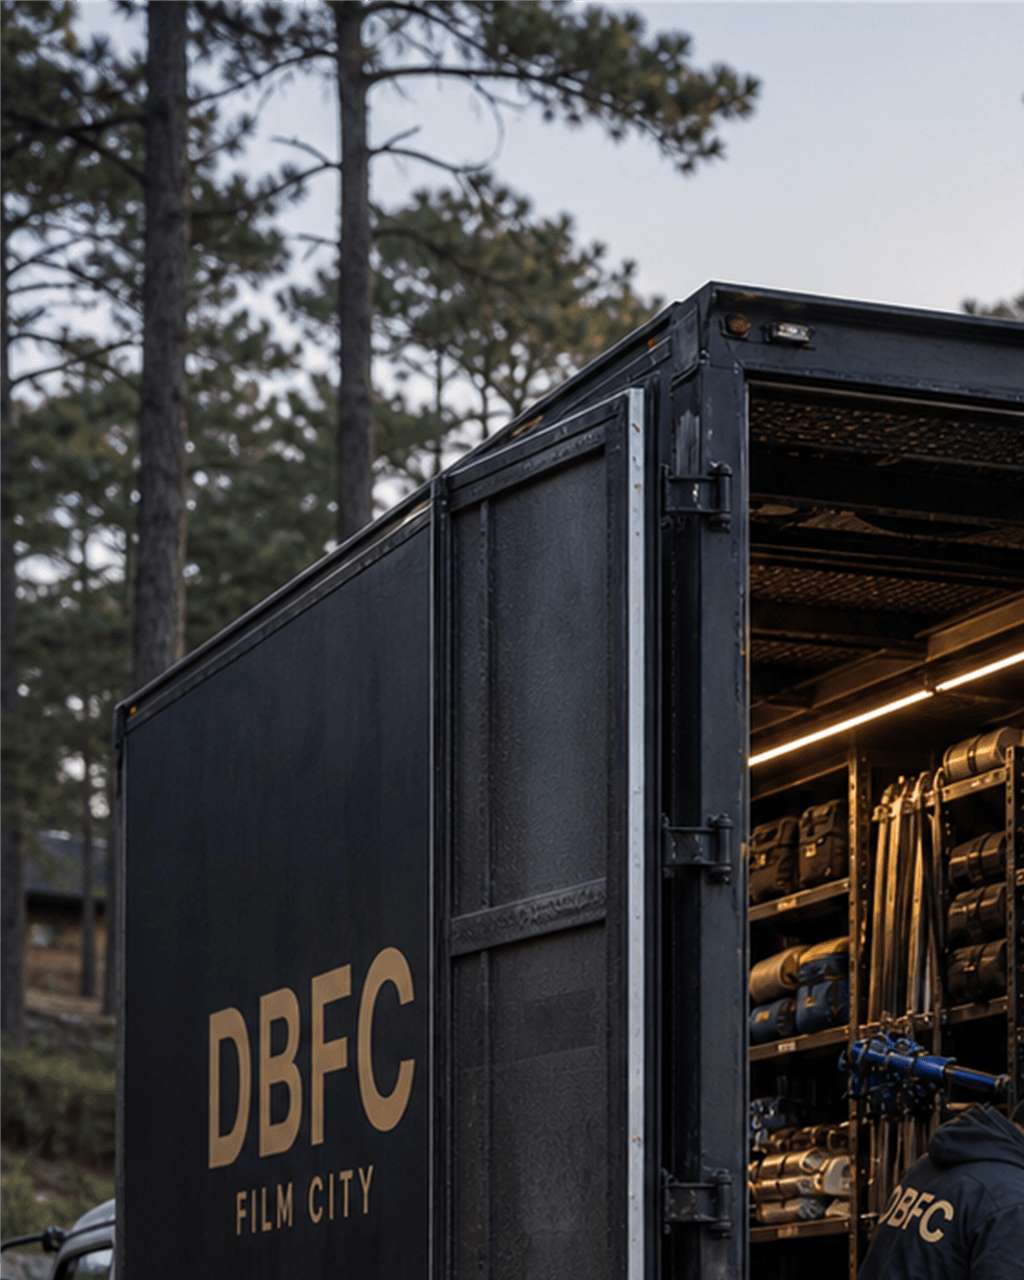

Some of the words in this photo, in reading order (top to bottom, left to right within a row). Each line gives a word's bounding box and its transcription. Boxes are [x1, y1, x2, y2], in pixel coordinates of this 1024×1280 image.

[207, 946, 416, 1170] DBFC
[236, 1181, 294, 1235] FILM
[308, 1164, 374, 1224] CITY
